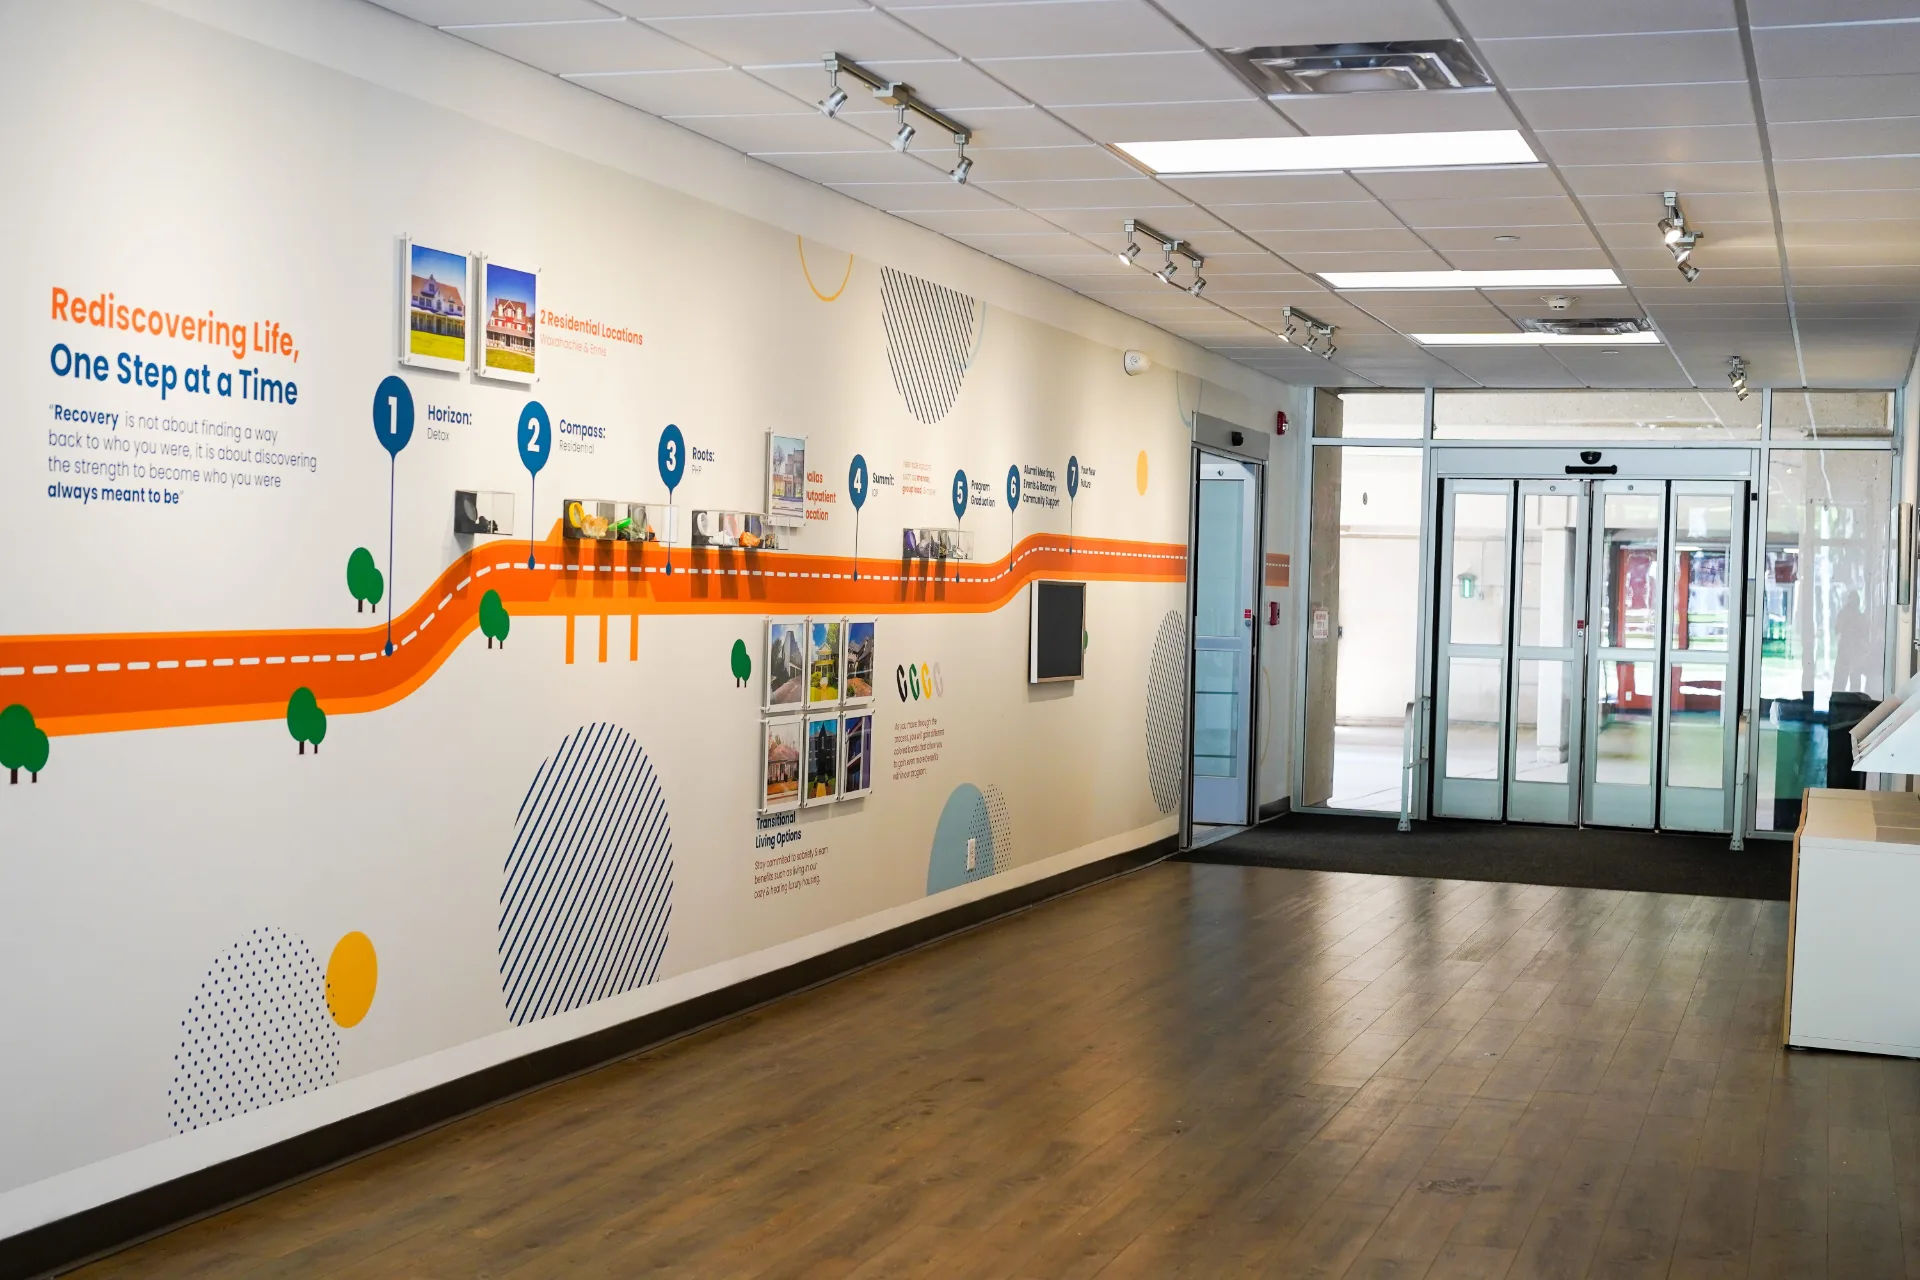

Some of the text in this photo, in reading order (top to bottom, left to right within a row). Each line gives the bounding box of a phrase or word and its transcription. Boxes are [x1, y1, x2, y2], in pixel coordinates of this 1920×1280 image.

[52, 286, 299, 363] Rediscovering Life,
[540, 309, 643, 346] 2 Residential Locations
[50, 343, 298, 405] One Step at a Time
[388, 396, 398, 435] 1
[428, 404, 472, 426] Horizon:
[125, 411, 135, 428] is
[139, 415, 159, 430] not
[162, 416, 199, 434] about
[202, 419, 241, 443] finding
[244, 427, 252, 440] a
[255, 429, 278, 446] way
[427, 427, 450, 441] Detox
[527, 417, 540, 452] 2
[560, 418, 606, 441] Compass:
[49, 429, 317, 473] back to who you were, it is about discovering
[559, 439, 595, 454] Residential
[666, 440, 677, 472] 3
[692, 446, 715, 462] Roots:
[48, 455, 281, 488] the strength to become who you were
[807, 471, 823, 483] allas
[853, 468, 862, 494] 4
[1071, 466, 1076, 487] 7
[48, 481, 98, 505] always
[101, 488, 145, 503] meant
[148, 488, 161, 503] to
[806, 490, 836, 504] utpatient
[957, 480, 964, 504] 5
[1010, 476, 1017, 498] 6
[806, 508, 829, 520] ocation
[756, 811, 796, 830] Transitional
[756, 829, 802, 849] Living Options
